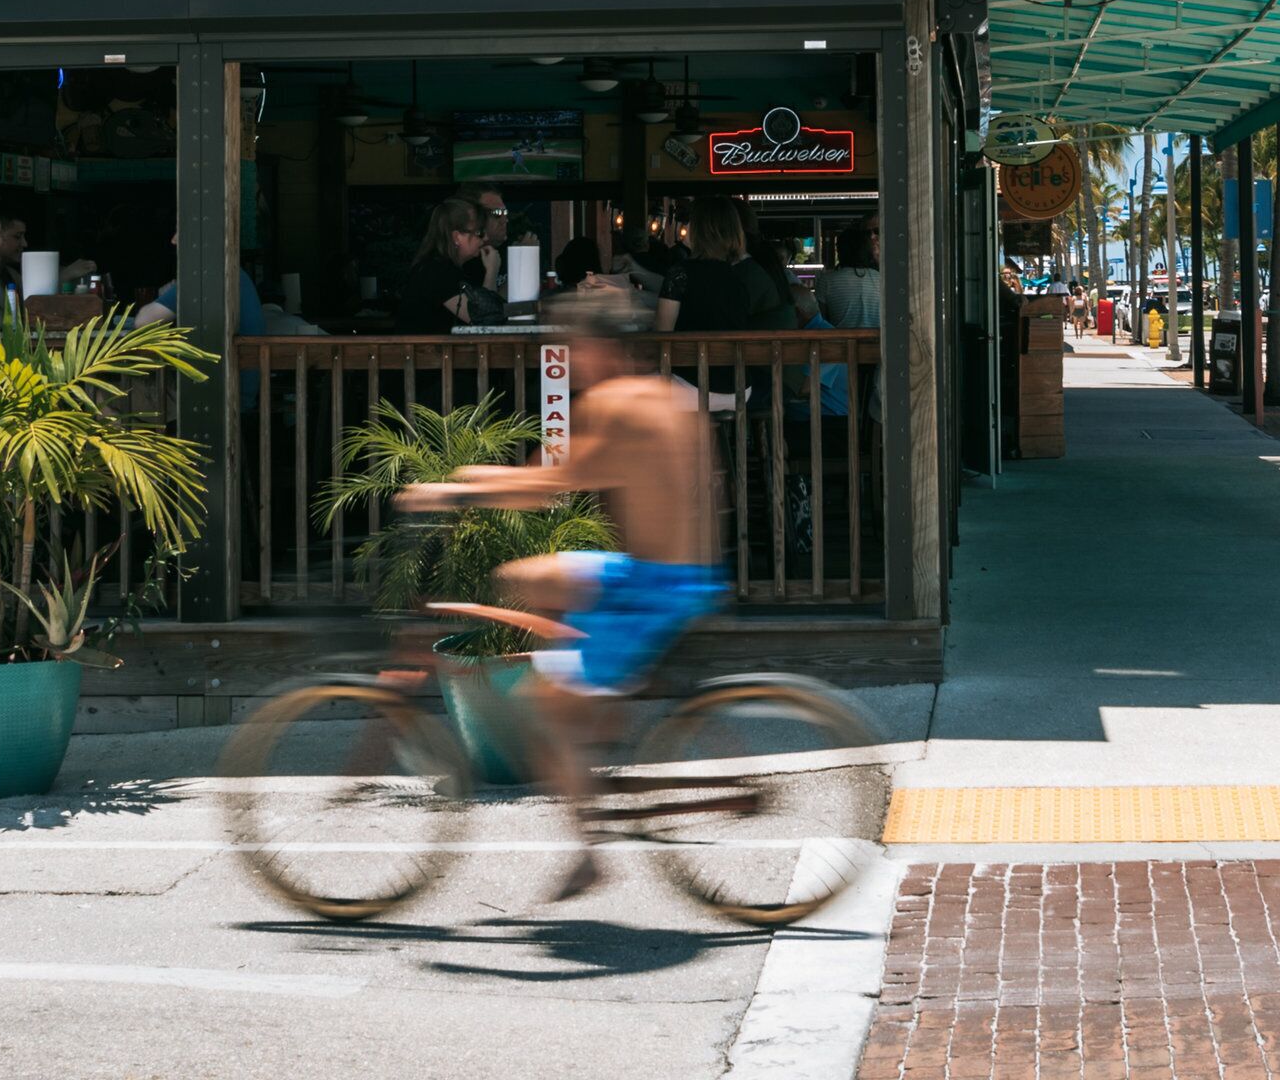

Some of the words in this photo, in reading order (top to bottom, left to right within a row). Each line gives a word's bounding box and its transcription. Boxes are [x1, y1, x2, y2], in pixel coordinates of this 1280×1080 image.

[714, 142, 850, 166] Budweiser
[545, 348, 566, 380] NO
[545, 394, 566, 467] PARKI
